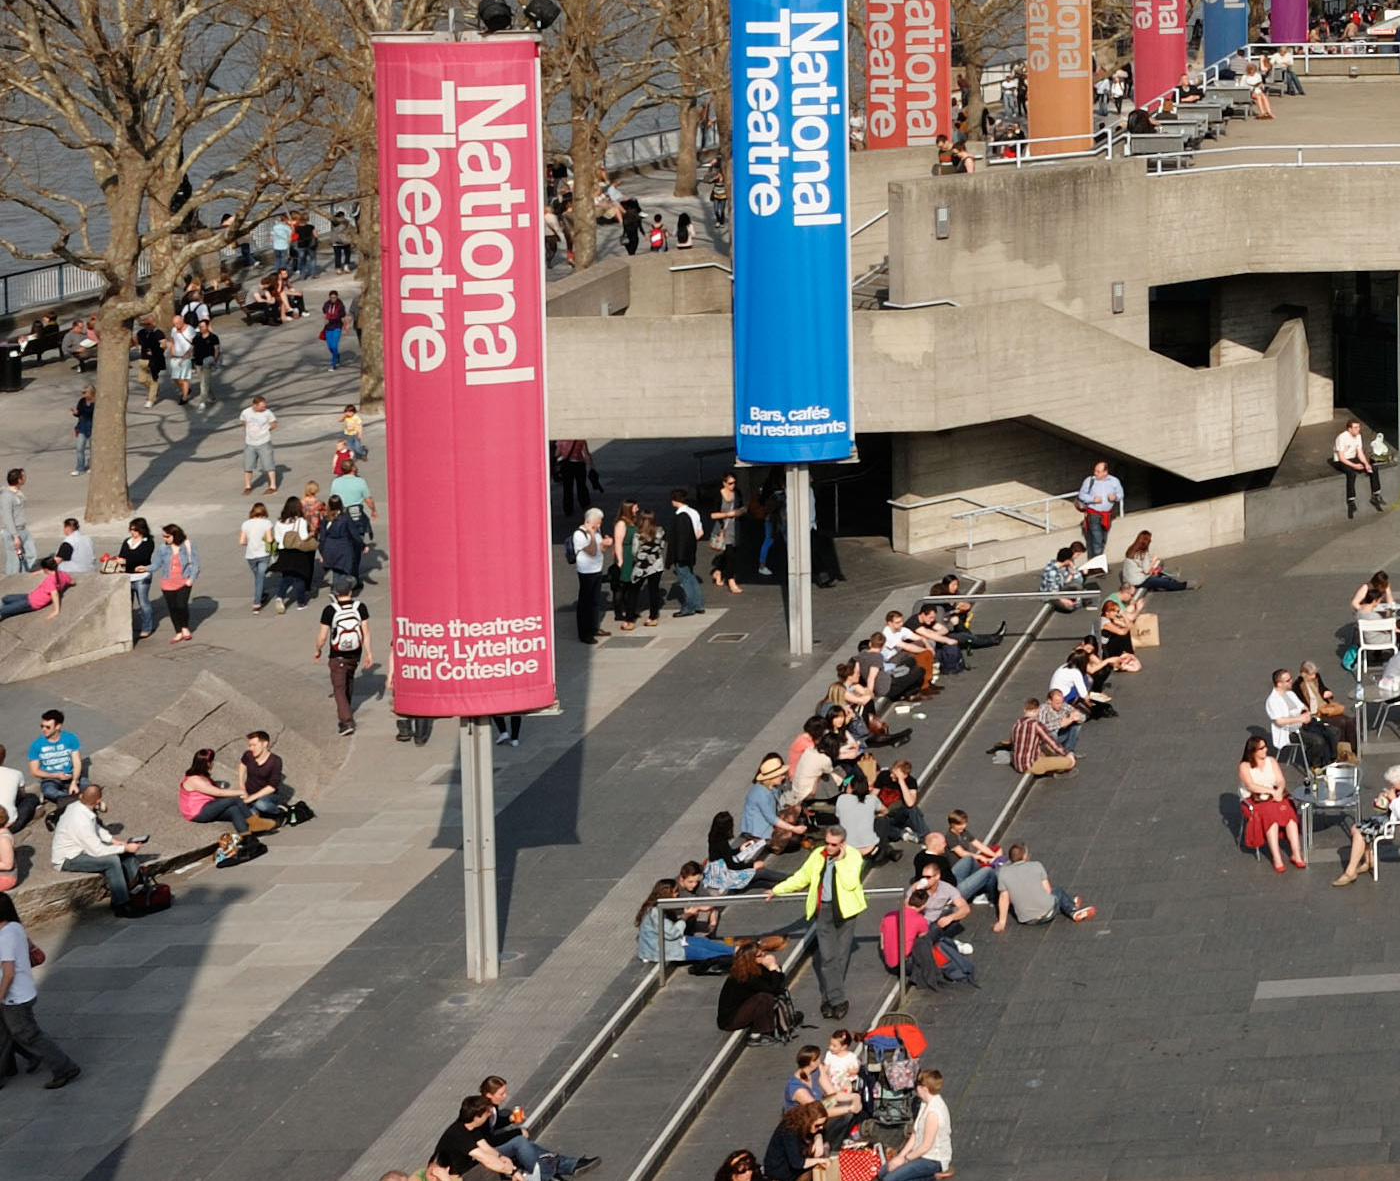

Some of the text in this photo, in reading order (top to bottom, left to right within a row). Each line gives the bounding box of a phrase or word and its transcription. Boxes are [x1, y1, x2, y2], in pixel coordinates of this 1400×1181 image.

[745, 9, 790, 217] Theatre
[790, 11, 842, 227] National
[395, 81, 457, 373] Theatre
[457, 84, 535, 386] National
[750, 405, 830, 423] Bars, cafés
[740, 420, 846, 436] and restaurants
[396, 616, 542, 637] Three theatres:
[396, 636, 545, 663] Olivier, Lyttelton
[402, 658, 538, 680] and Cottesloe
